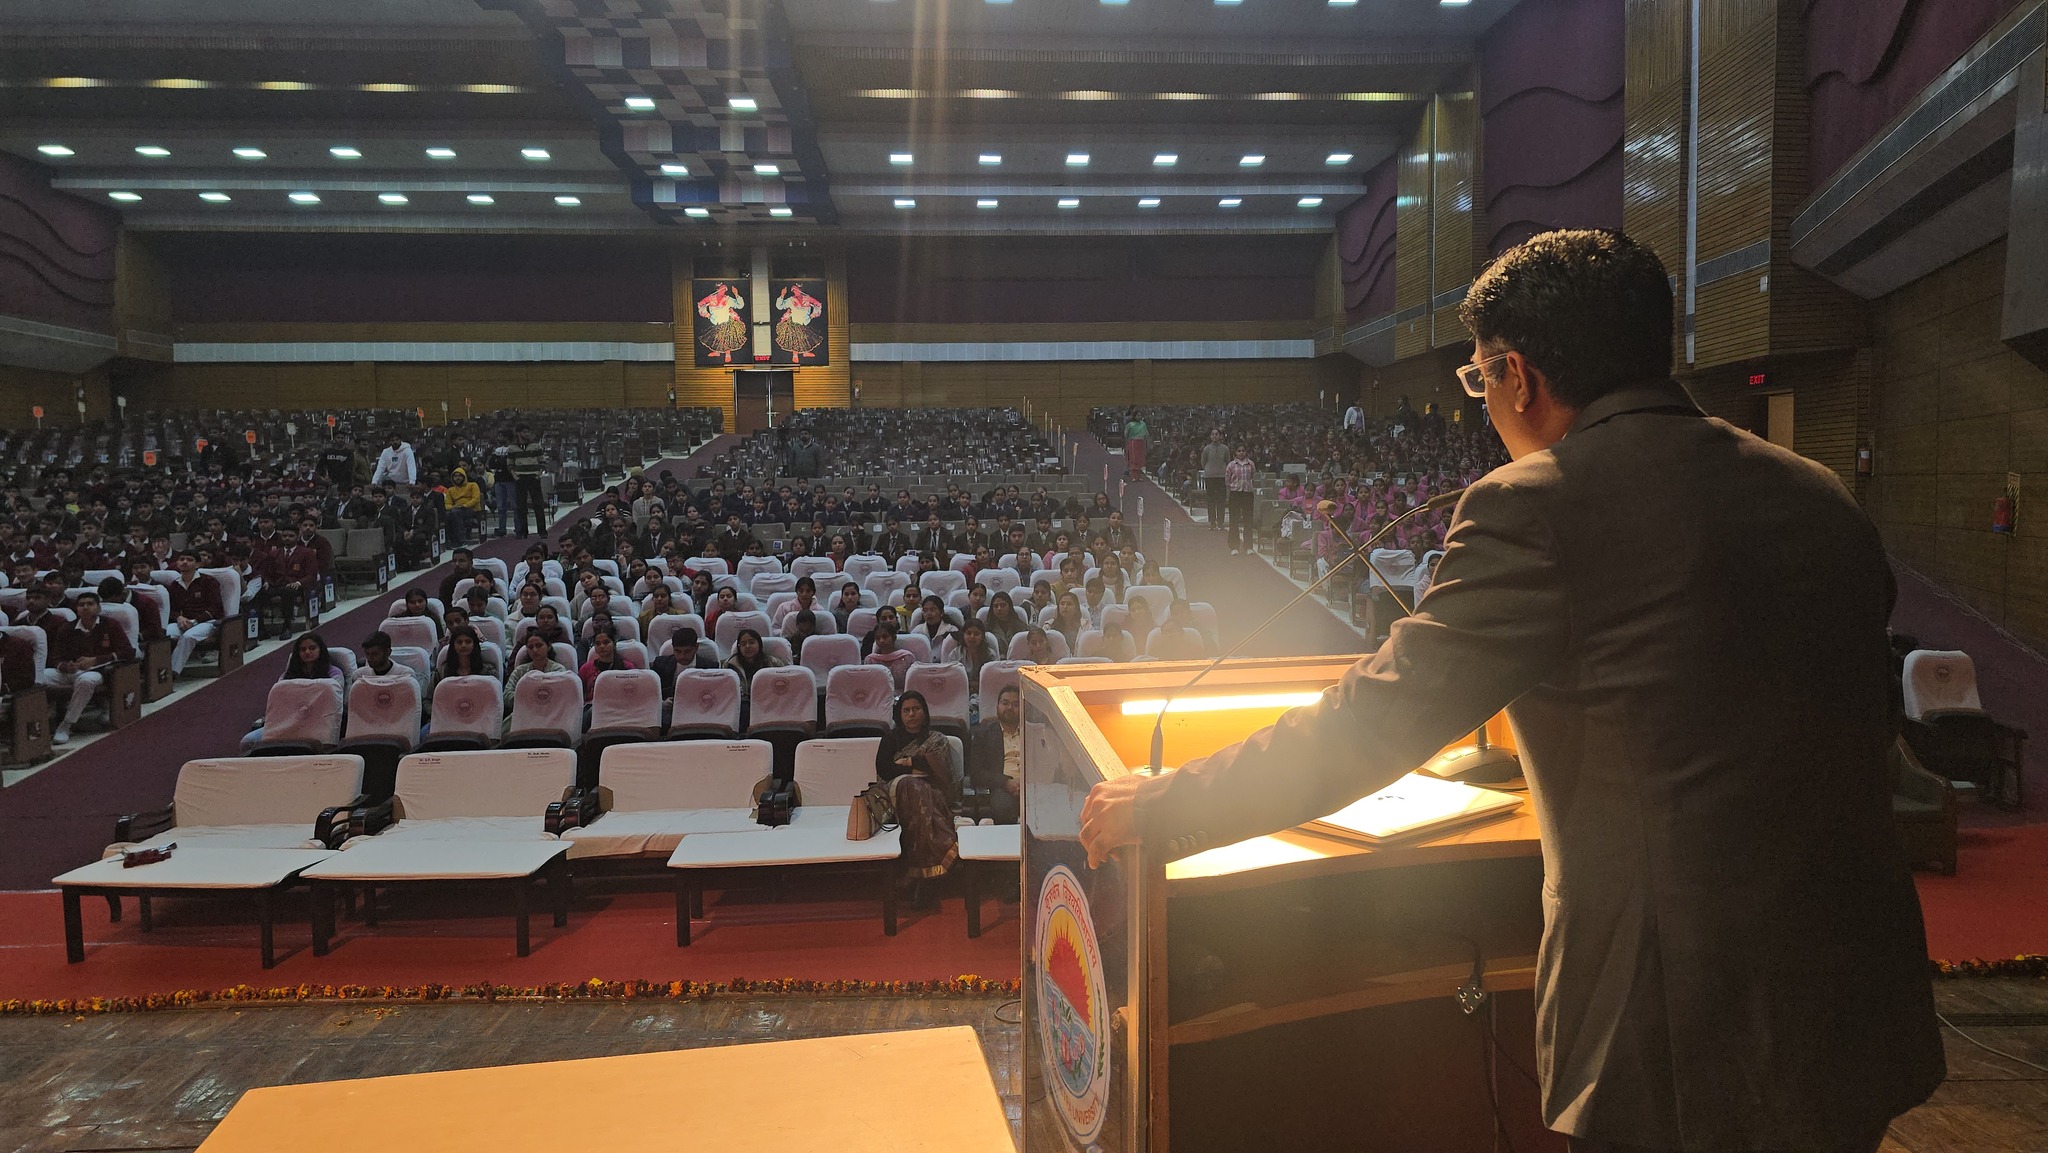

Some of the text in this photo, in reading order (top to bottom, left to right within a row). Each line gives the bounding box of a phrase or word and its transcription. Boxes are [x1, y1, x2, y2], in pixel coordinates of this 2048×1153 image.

[1749, 374, 1765, 385] EXIT
[250, 624, 256, 633] G
[1072, 1092, 1101, 1126] UNIVERSITY
